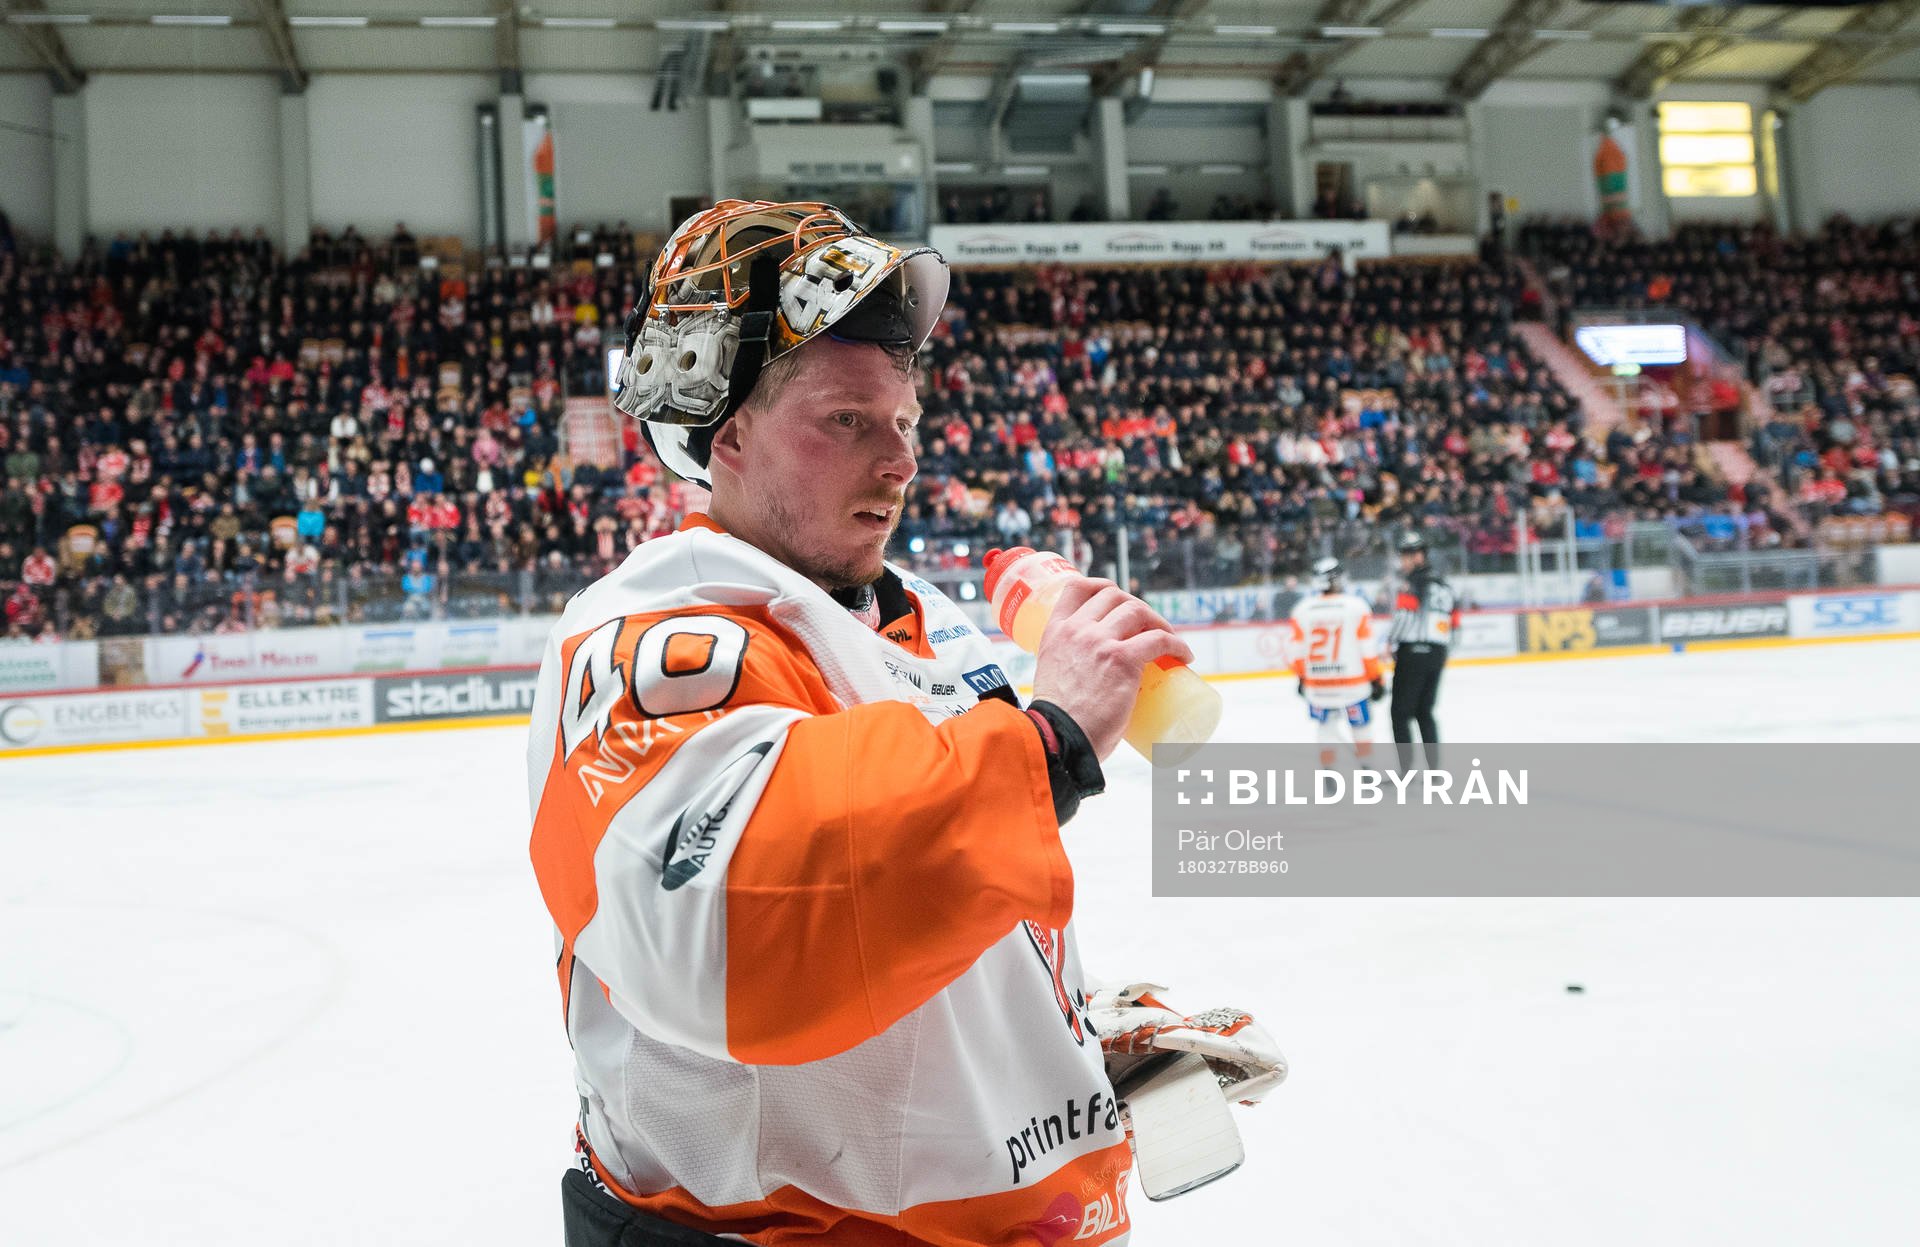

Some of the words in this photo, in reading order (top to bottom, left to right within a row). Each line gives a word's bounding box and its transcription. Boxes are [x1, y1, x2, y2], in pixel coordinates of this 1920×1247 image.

[1309, 617, 1341, 661] 21
[1528, 609, 1597, 650] NP3
[1662, 607, 1787, 637] BAUER
[238, 687, 359, 708] ELLEXTRE
[386, 676, 536, 716] stadium
[561, 615, 749, 768] 40
[54, 702, 180, 725] ENGBERGS
